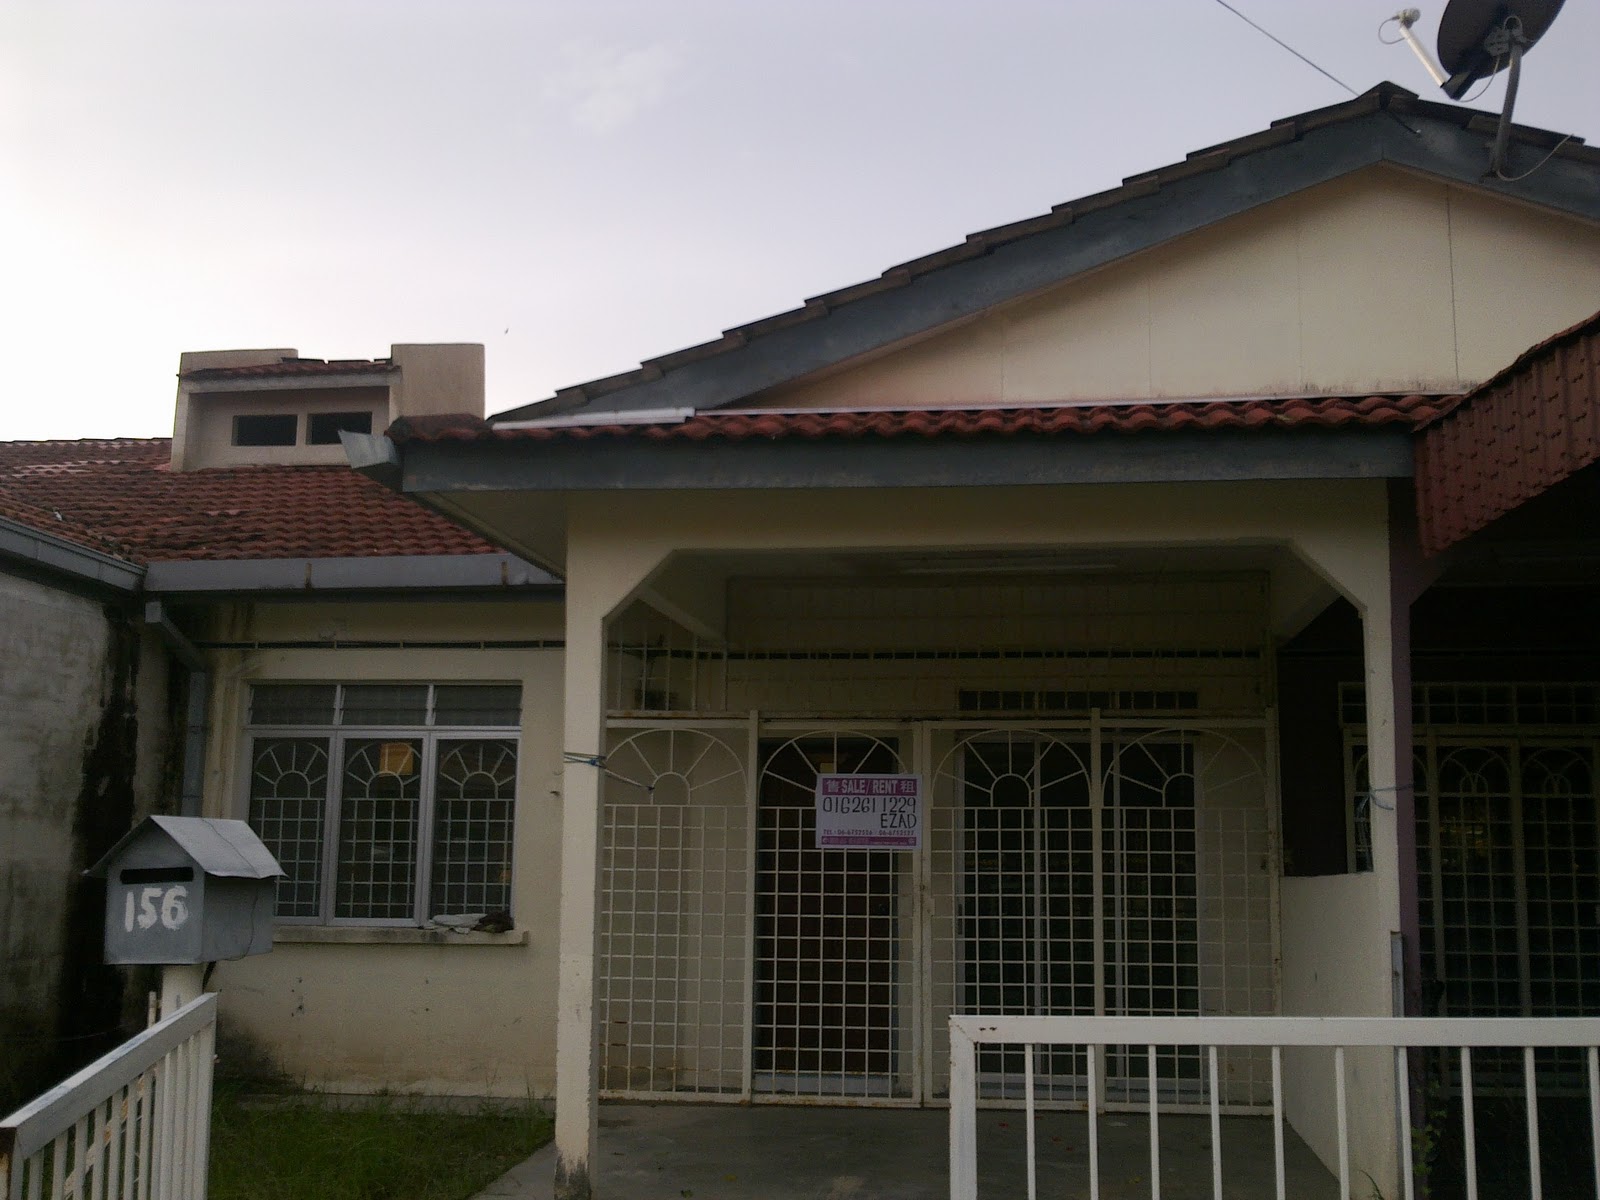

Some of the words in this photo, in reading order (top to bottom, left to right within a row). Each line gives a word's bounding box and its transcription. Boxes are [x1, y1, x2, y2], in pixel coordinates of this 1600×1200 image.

[900, 780, 915, 793] 租
[880, 813, 917, 829] EZAD
[124, 884, 189, 933] 156
